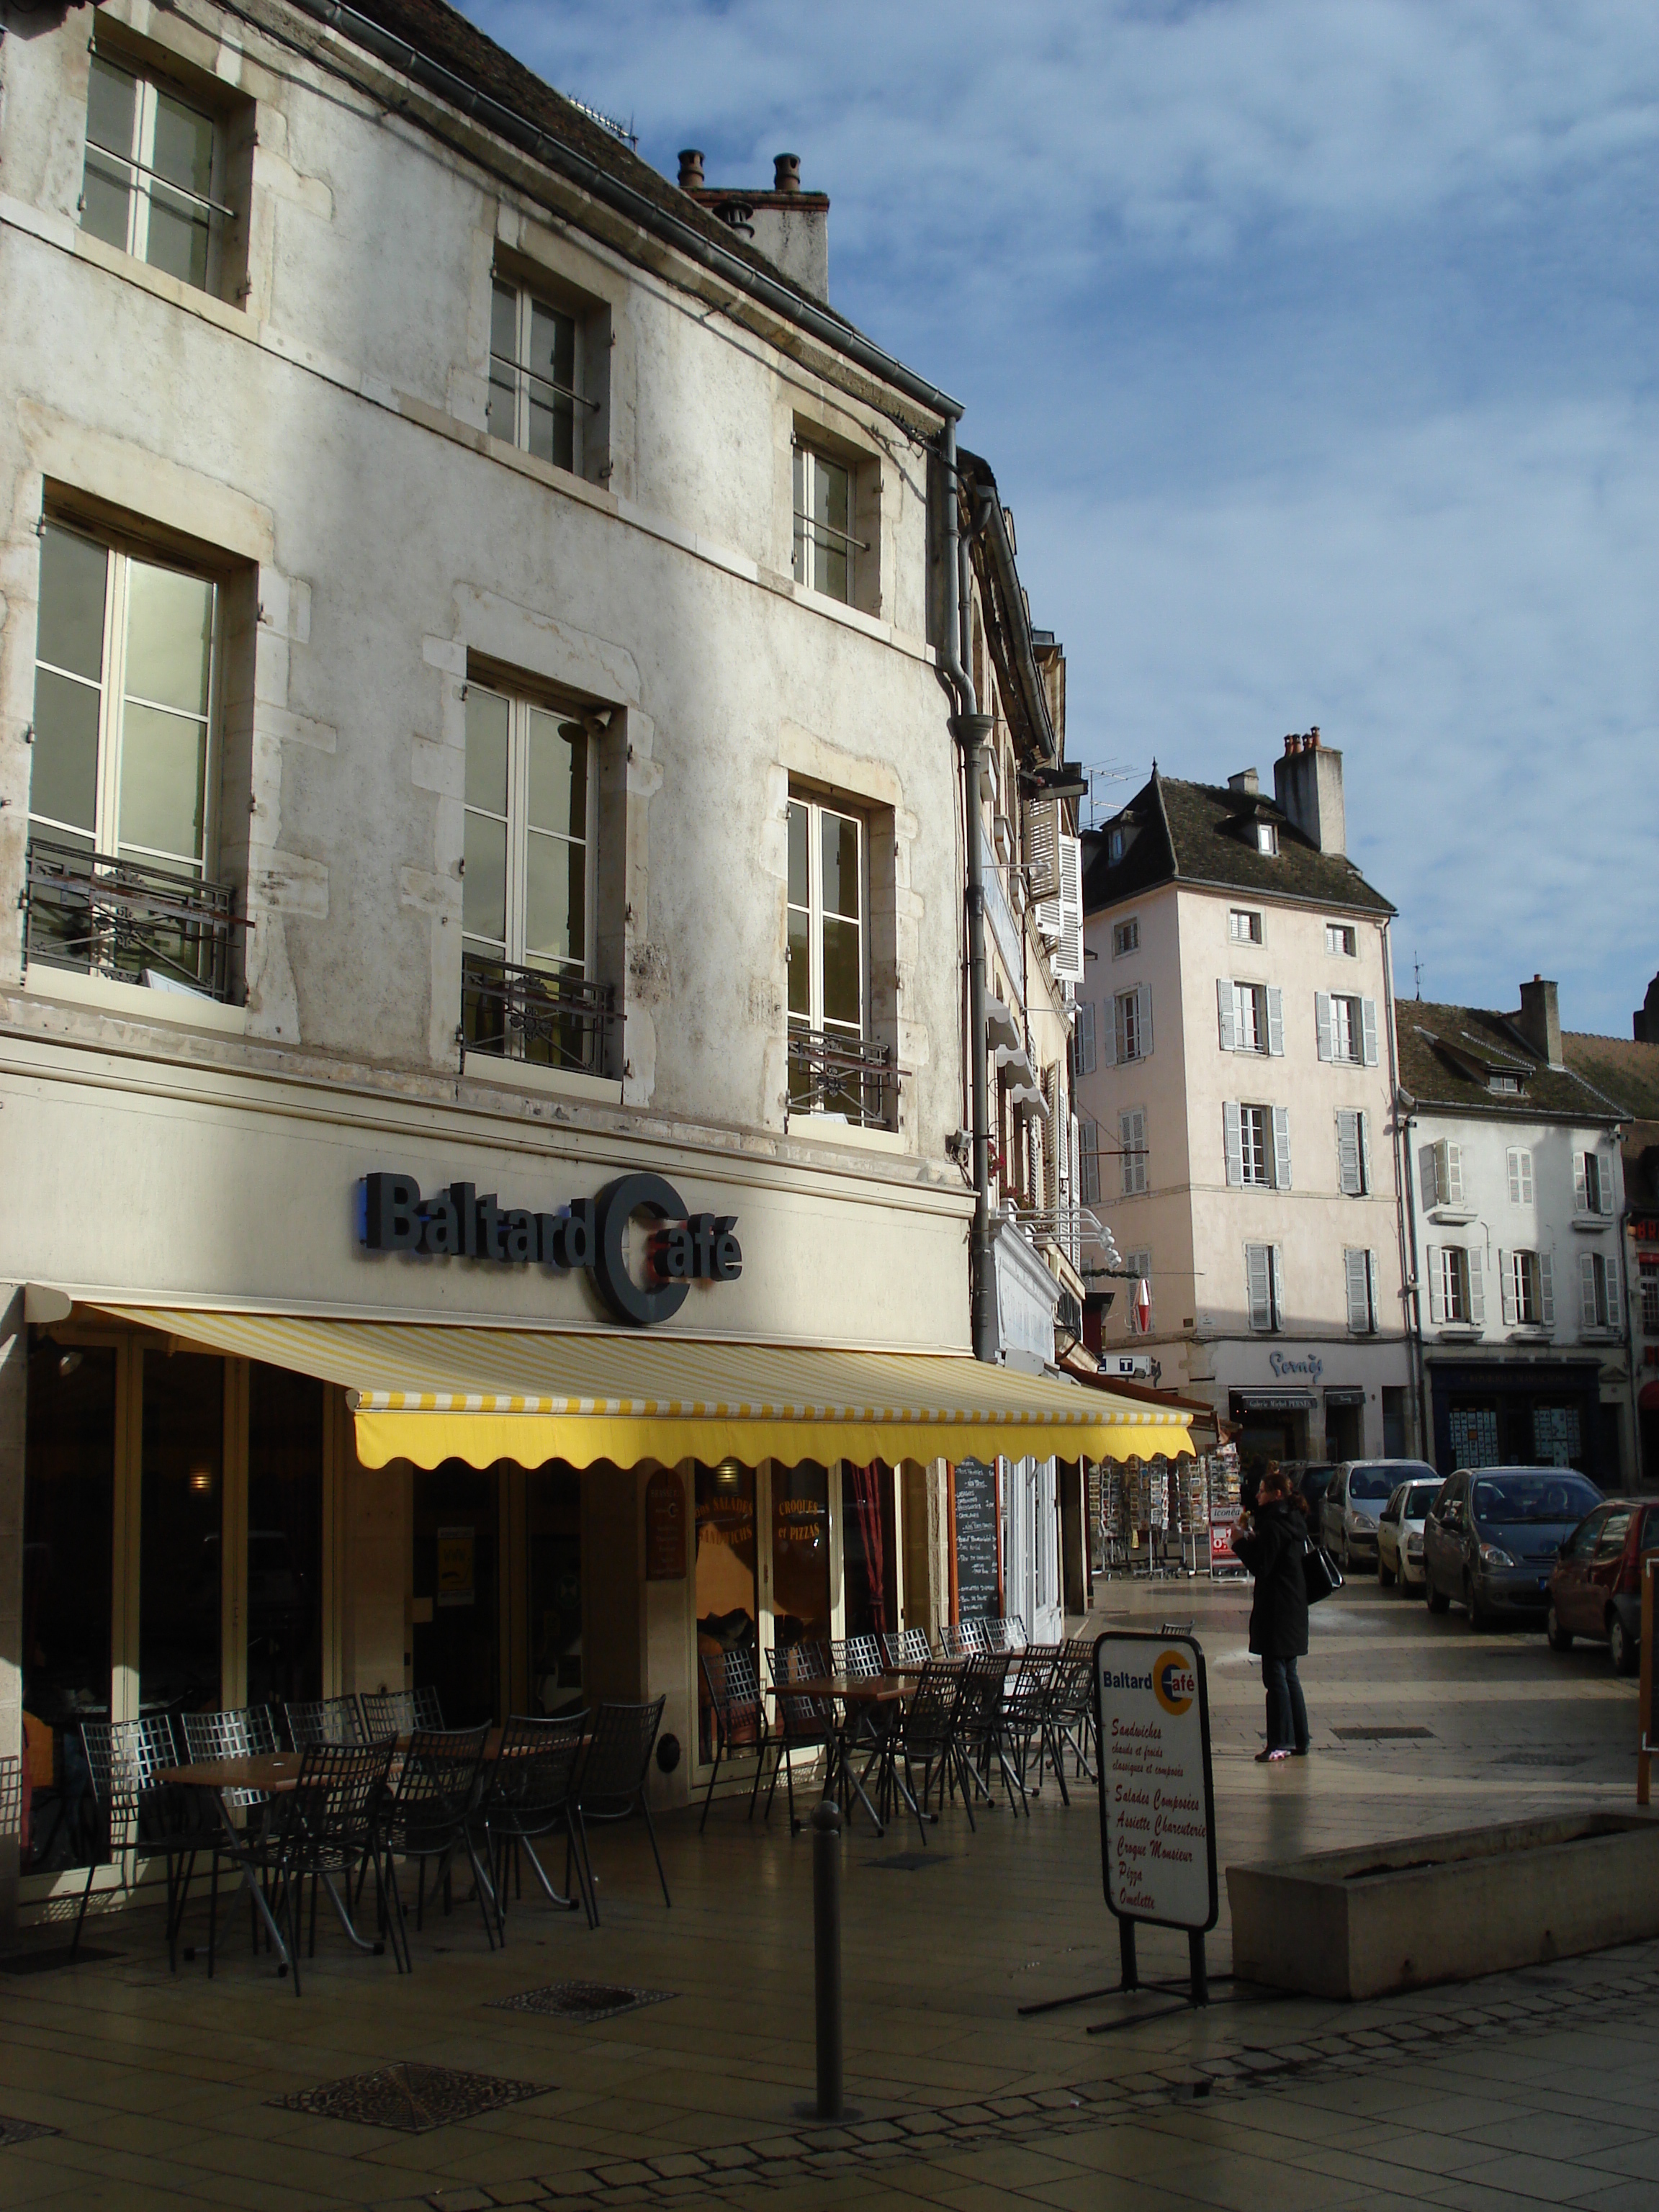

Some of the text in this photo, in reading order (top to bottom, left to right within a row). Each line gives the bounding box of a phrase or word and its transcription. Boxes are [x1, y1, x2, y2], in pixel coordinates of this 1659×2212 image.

[1638, 1220, 1659, 1241] BR
[364, 1172, 742, 1323] Baltard Café
[714, 1497, 753, 1516] SALADES
[778, 1499, 819, 1516] CROQUES
[778, 1522, 820, 1540] et PIZZAS
[1103, 1650, 1195, 1716] Baltard Café
[1112, 1718, 1162, 1740] Sandwiches
[1112, 1742, 1163, 1761] chauds et froids
[1112, 1759, 1143, 1776] classiques
[1146, 1763, 1152, 1773] et
[1115, 1784, 1199, 1812] Salades Composées
[1116, 1810, 1207, 1838] Assiette Charcuterie
[1117, 1835, 1193, 1863] Croque Monsieur
[1119, 1861, 1143, 1887] Pizza
[1120, 1887, 1155, 1910] Omelette
